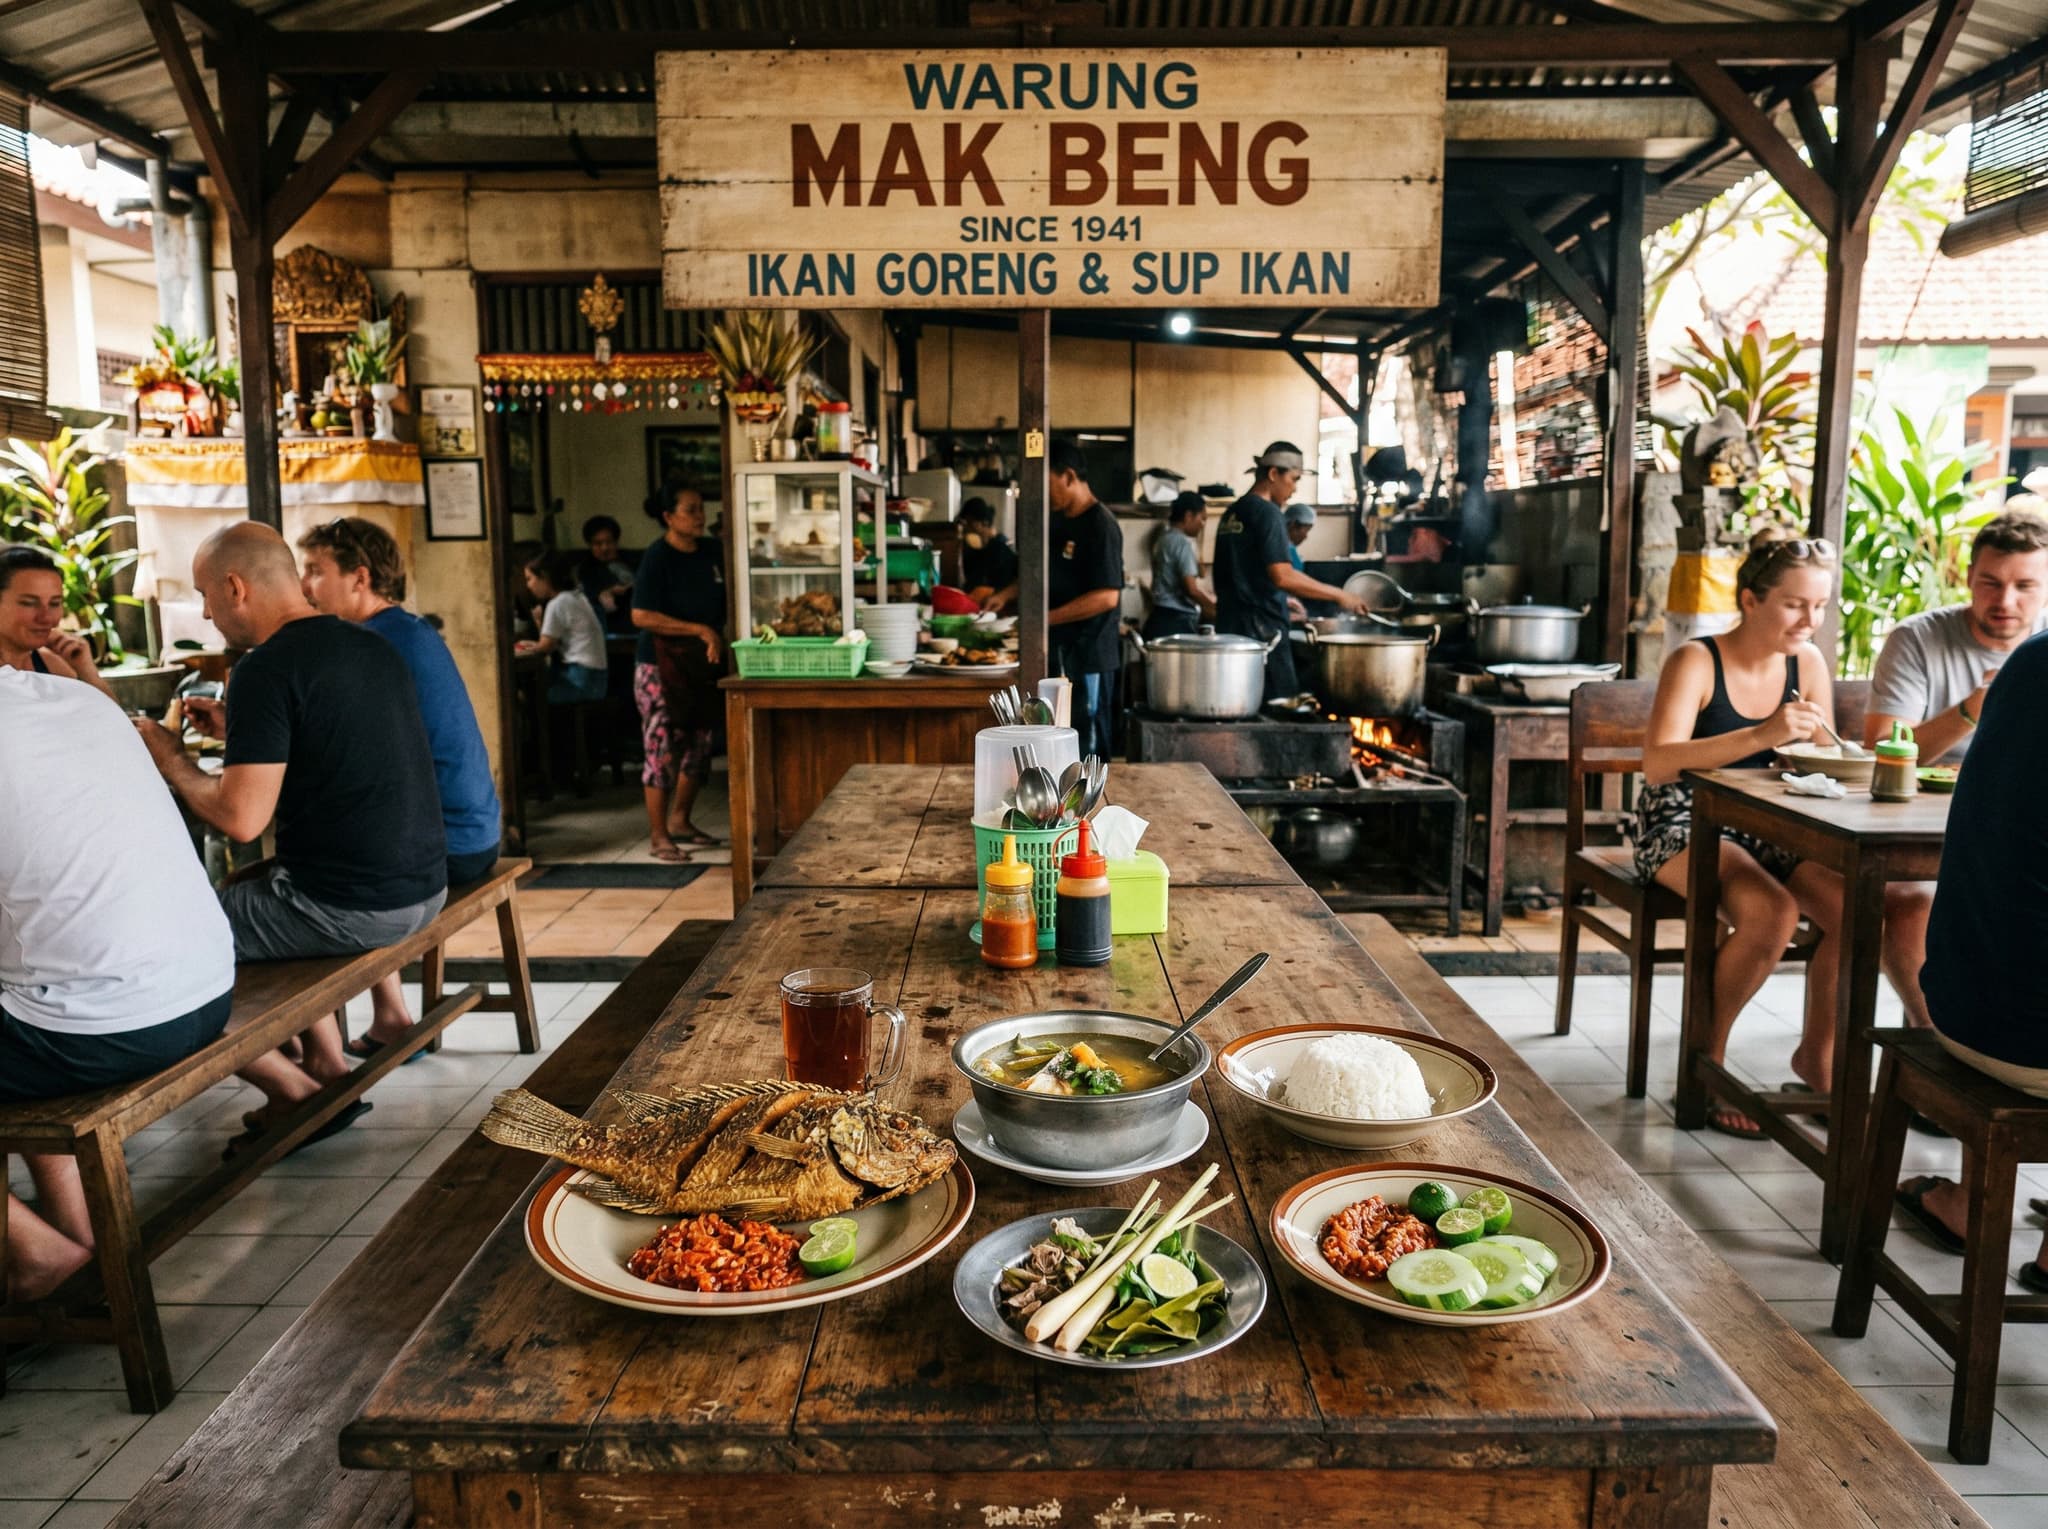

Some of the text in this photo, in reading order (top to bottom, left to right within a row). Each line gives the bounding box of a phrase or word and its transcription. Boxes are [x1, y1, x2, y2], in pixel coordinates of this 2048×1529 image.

[902, 62, 1198, 110] WARUNG
[790, 120, 1310, 207] MAK BENG
[960, 216, 1140, 242] SINCE 1941
[748, 252, 1349, 296] IKAN GORENG & SUP IKAN
